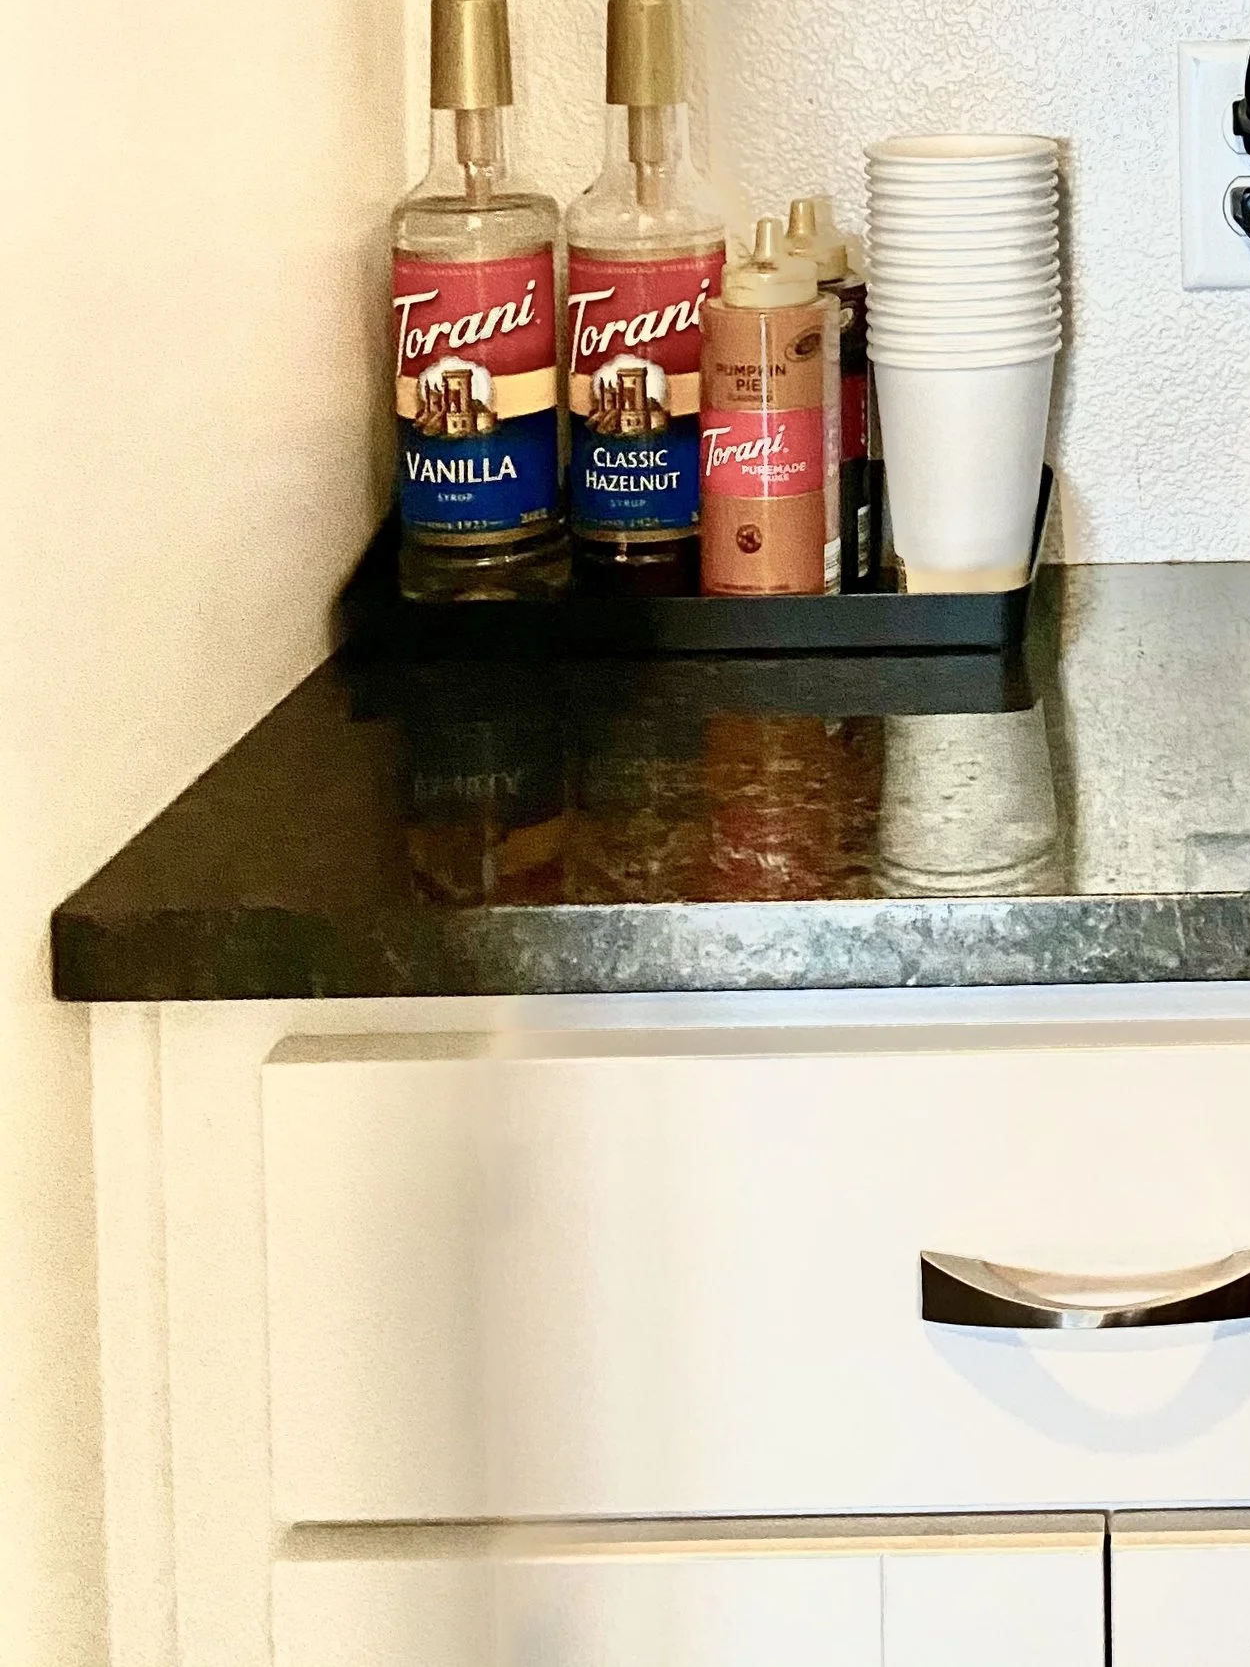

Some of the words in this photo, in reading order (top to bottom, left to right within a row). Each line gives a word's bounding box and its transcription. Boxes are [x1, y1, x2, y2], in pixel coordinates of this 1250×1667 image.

[393, 279, 536, 377] Torani
[567, 278, 710, 375] Torani
[736, 379, 762, 392] PIE
[593, 447, 668, 468] CLASSIC
[703, 424, 786, 476] Torani
[406, 451, 518, 484] VANILLA
[586, 470, 681, 492] HAZELNUT
